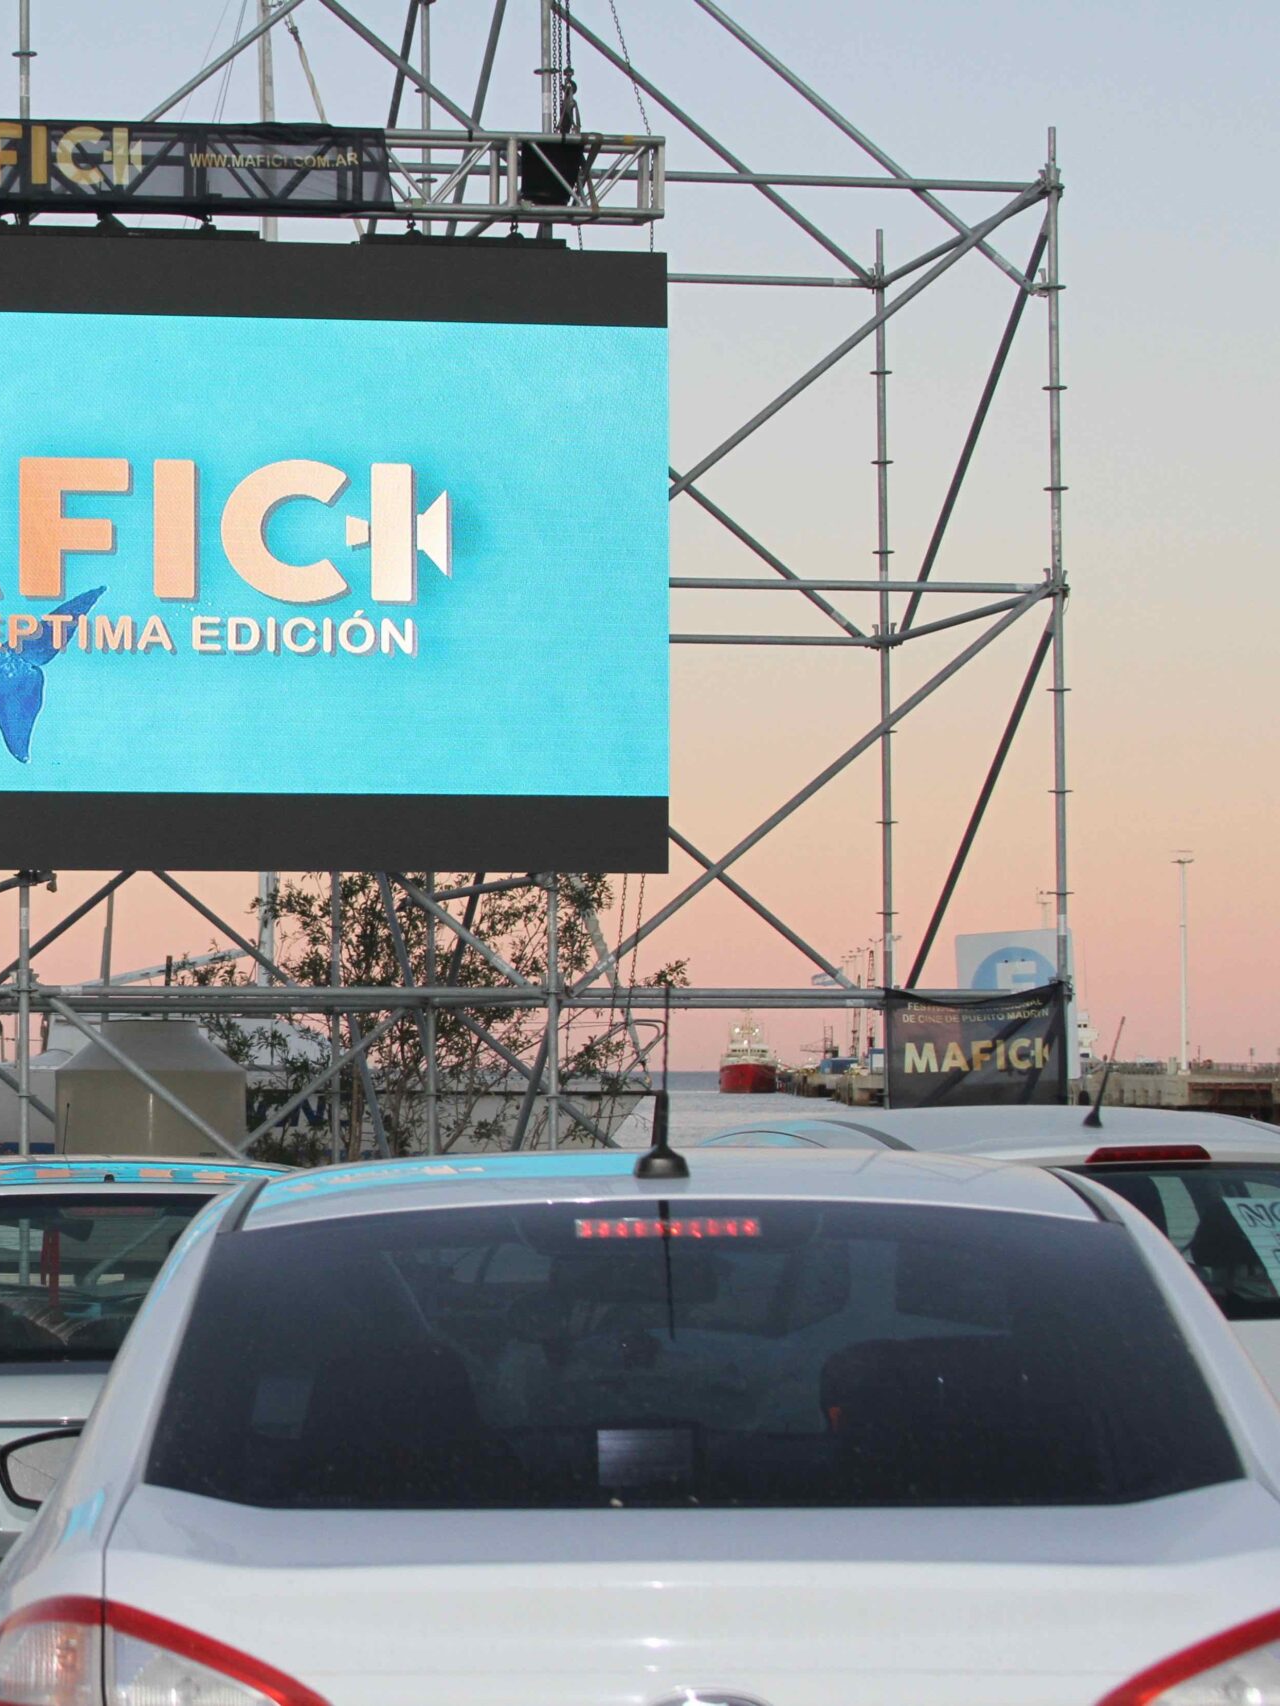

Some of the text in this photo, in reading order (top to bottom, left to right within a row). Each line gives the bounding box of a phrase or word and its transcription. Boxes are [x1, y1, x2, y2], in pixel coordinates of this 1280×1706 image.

[189, 152, 360, 168] WWW.MAFICI.COM.AR
[191, 609, 417, 657] EDICIÓN
[902, 1013, 917, 1024] DE
[945, 1014, 961, 1024] DE
[962, 1013, 1006, 1024] PUERTO
[1007, 1008, 1050, 1021] MADRYN
